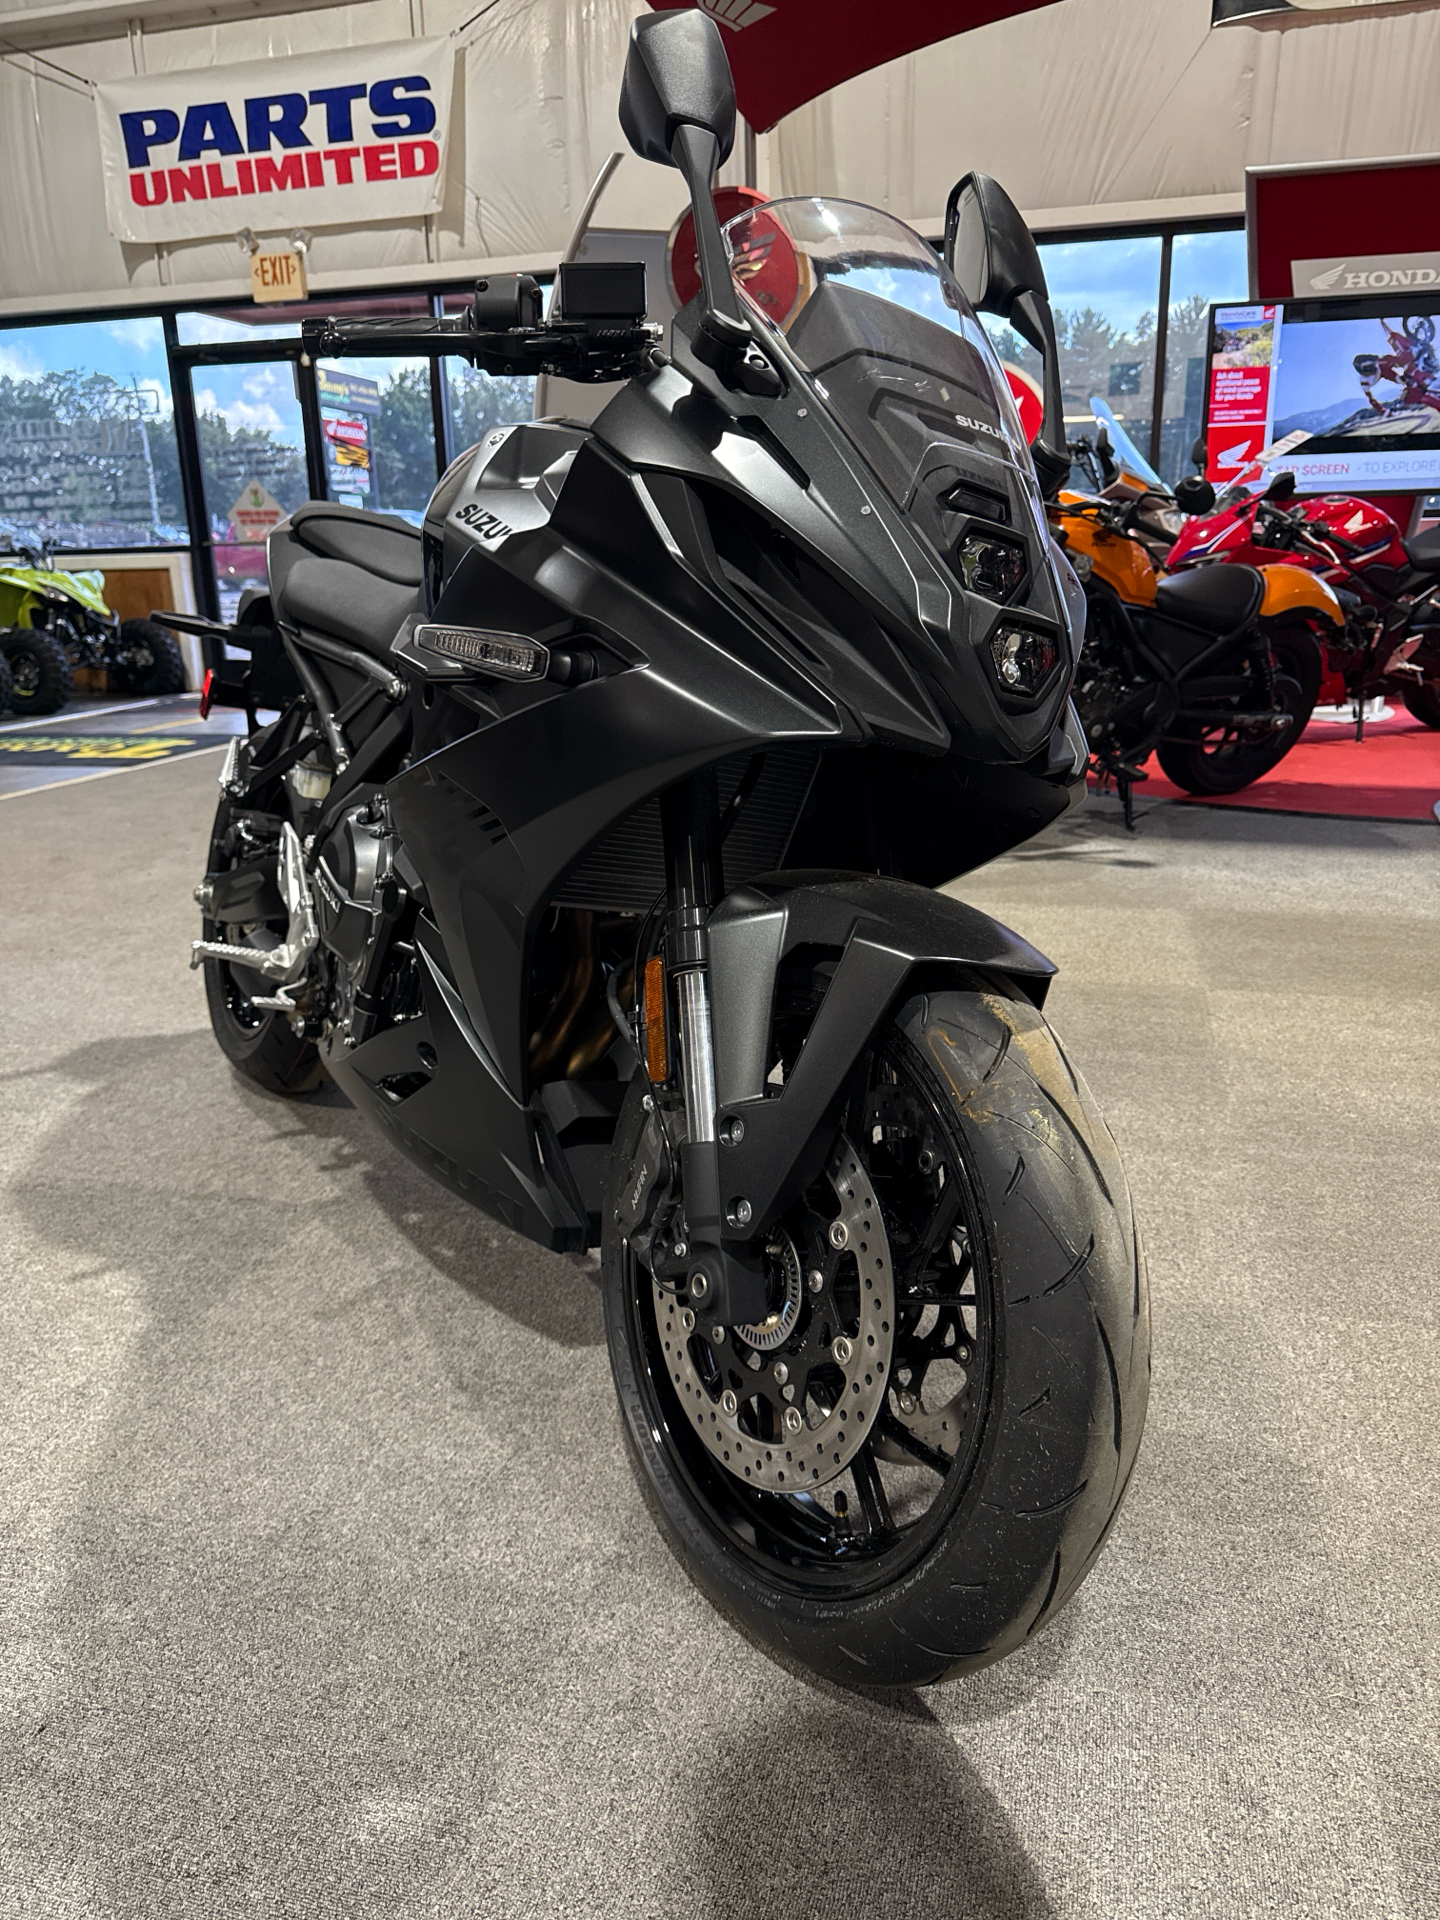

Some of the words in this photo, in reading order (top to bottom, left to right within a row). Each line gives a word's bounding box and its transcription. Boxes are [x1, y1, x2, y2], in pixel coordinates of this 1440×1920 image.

[119, 75, 437, 169] PARTS
[129, 139, 440, 208] UNLIMITED
[259, 254, 291, 287] EXIT
[1343, 268, 1440, 289] HOND
[1302, 463, 1350, 476] SCREEN
[1363, 461, 1380, 474] TO
[1382, 459, 1437, 474] EXPLORE
